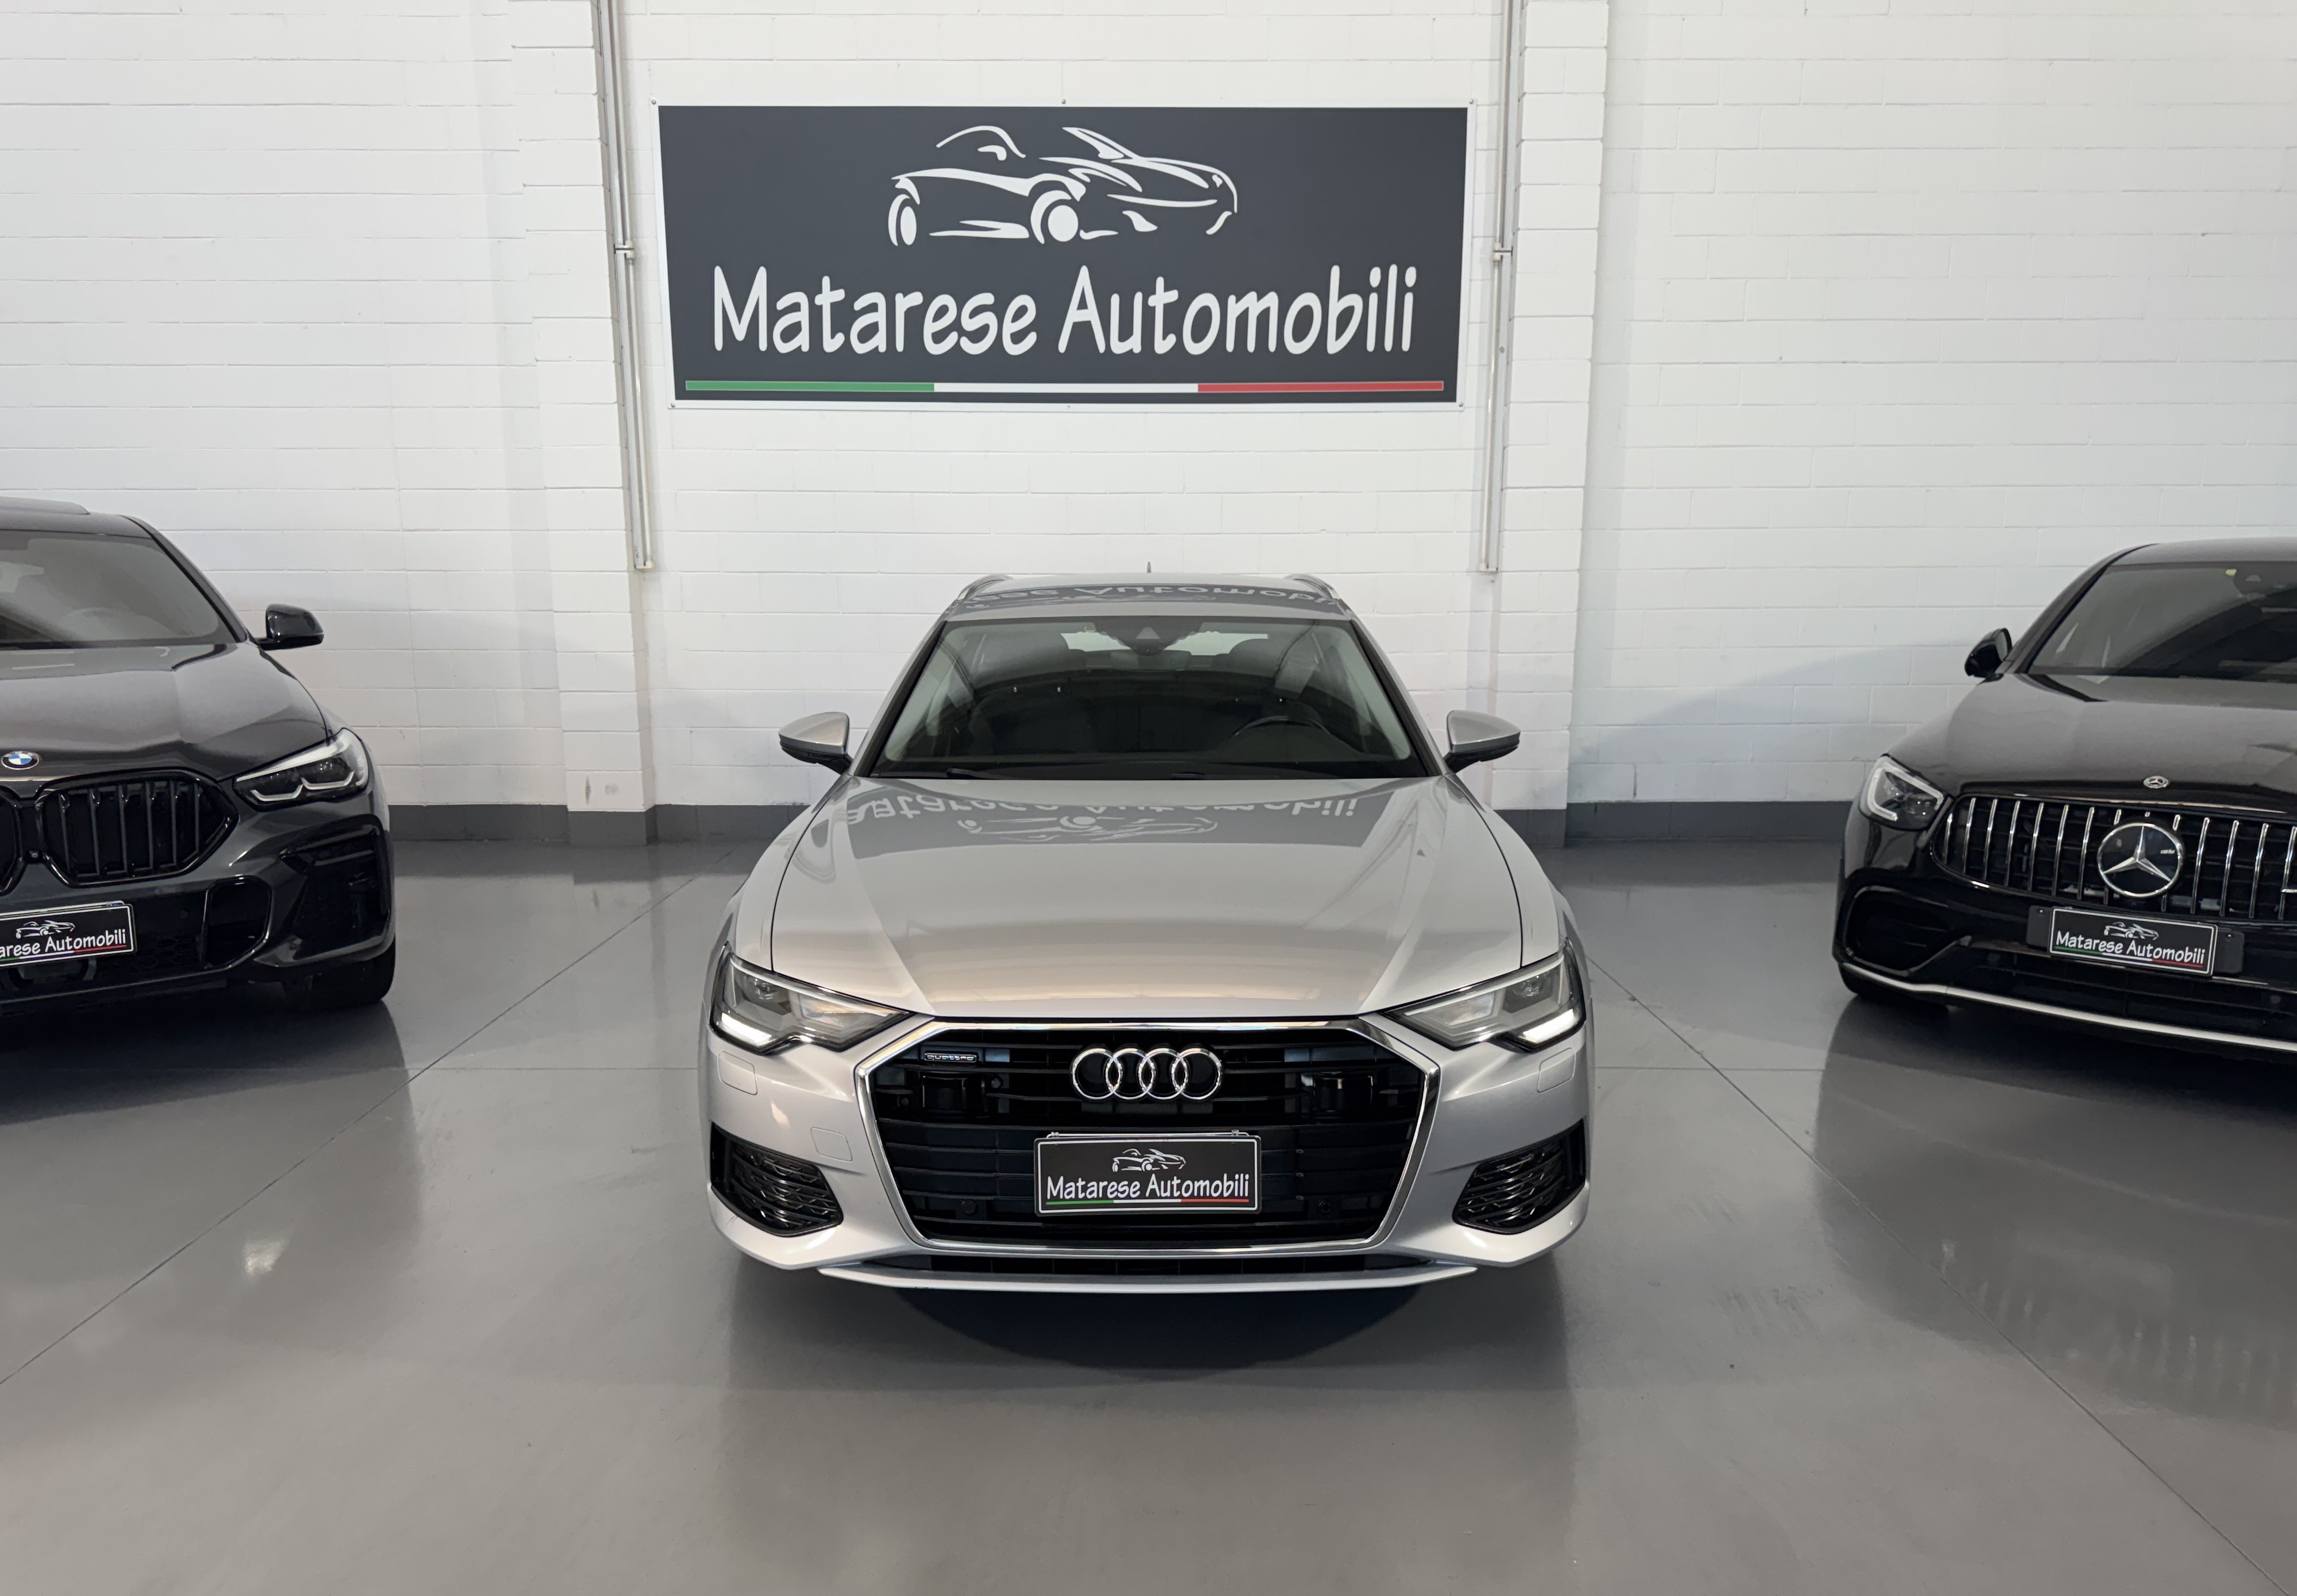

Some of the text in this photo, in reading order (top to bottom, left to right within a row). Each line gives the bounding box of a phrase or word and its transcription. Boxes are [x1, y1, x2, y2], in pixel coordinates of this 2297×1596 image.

[714, 264, 1417, 356] Matarese Automobili
[45, 929, 126, 952] Automobili
[2056, 931, 2205, 964] Matarese Automobili
[1047, 1173, 1250, 1199] Matarese Automobili
